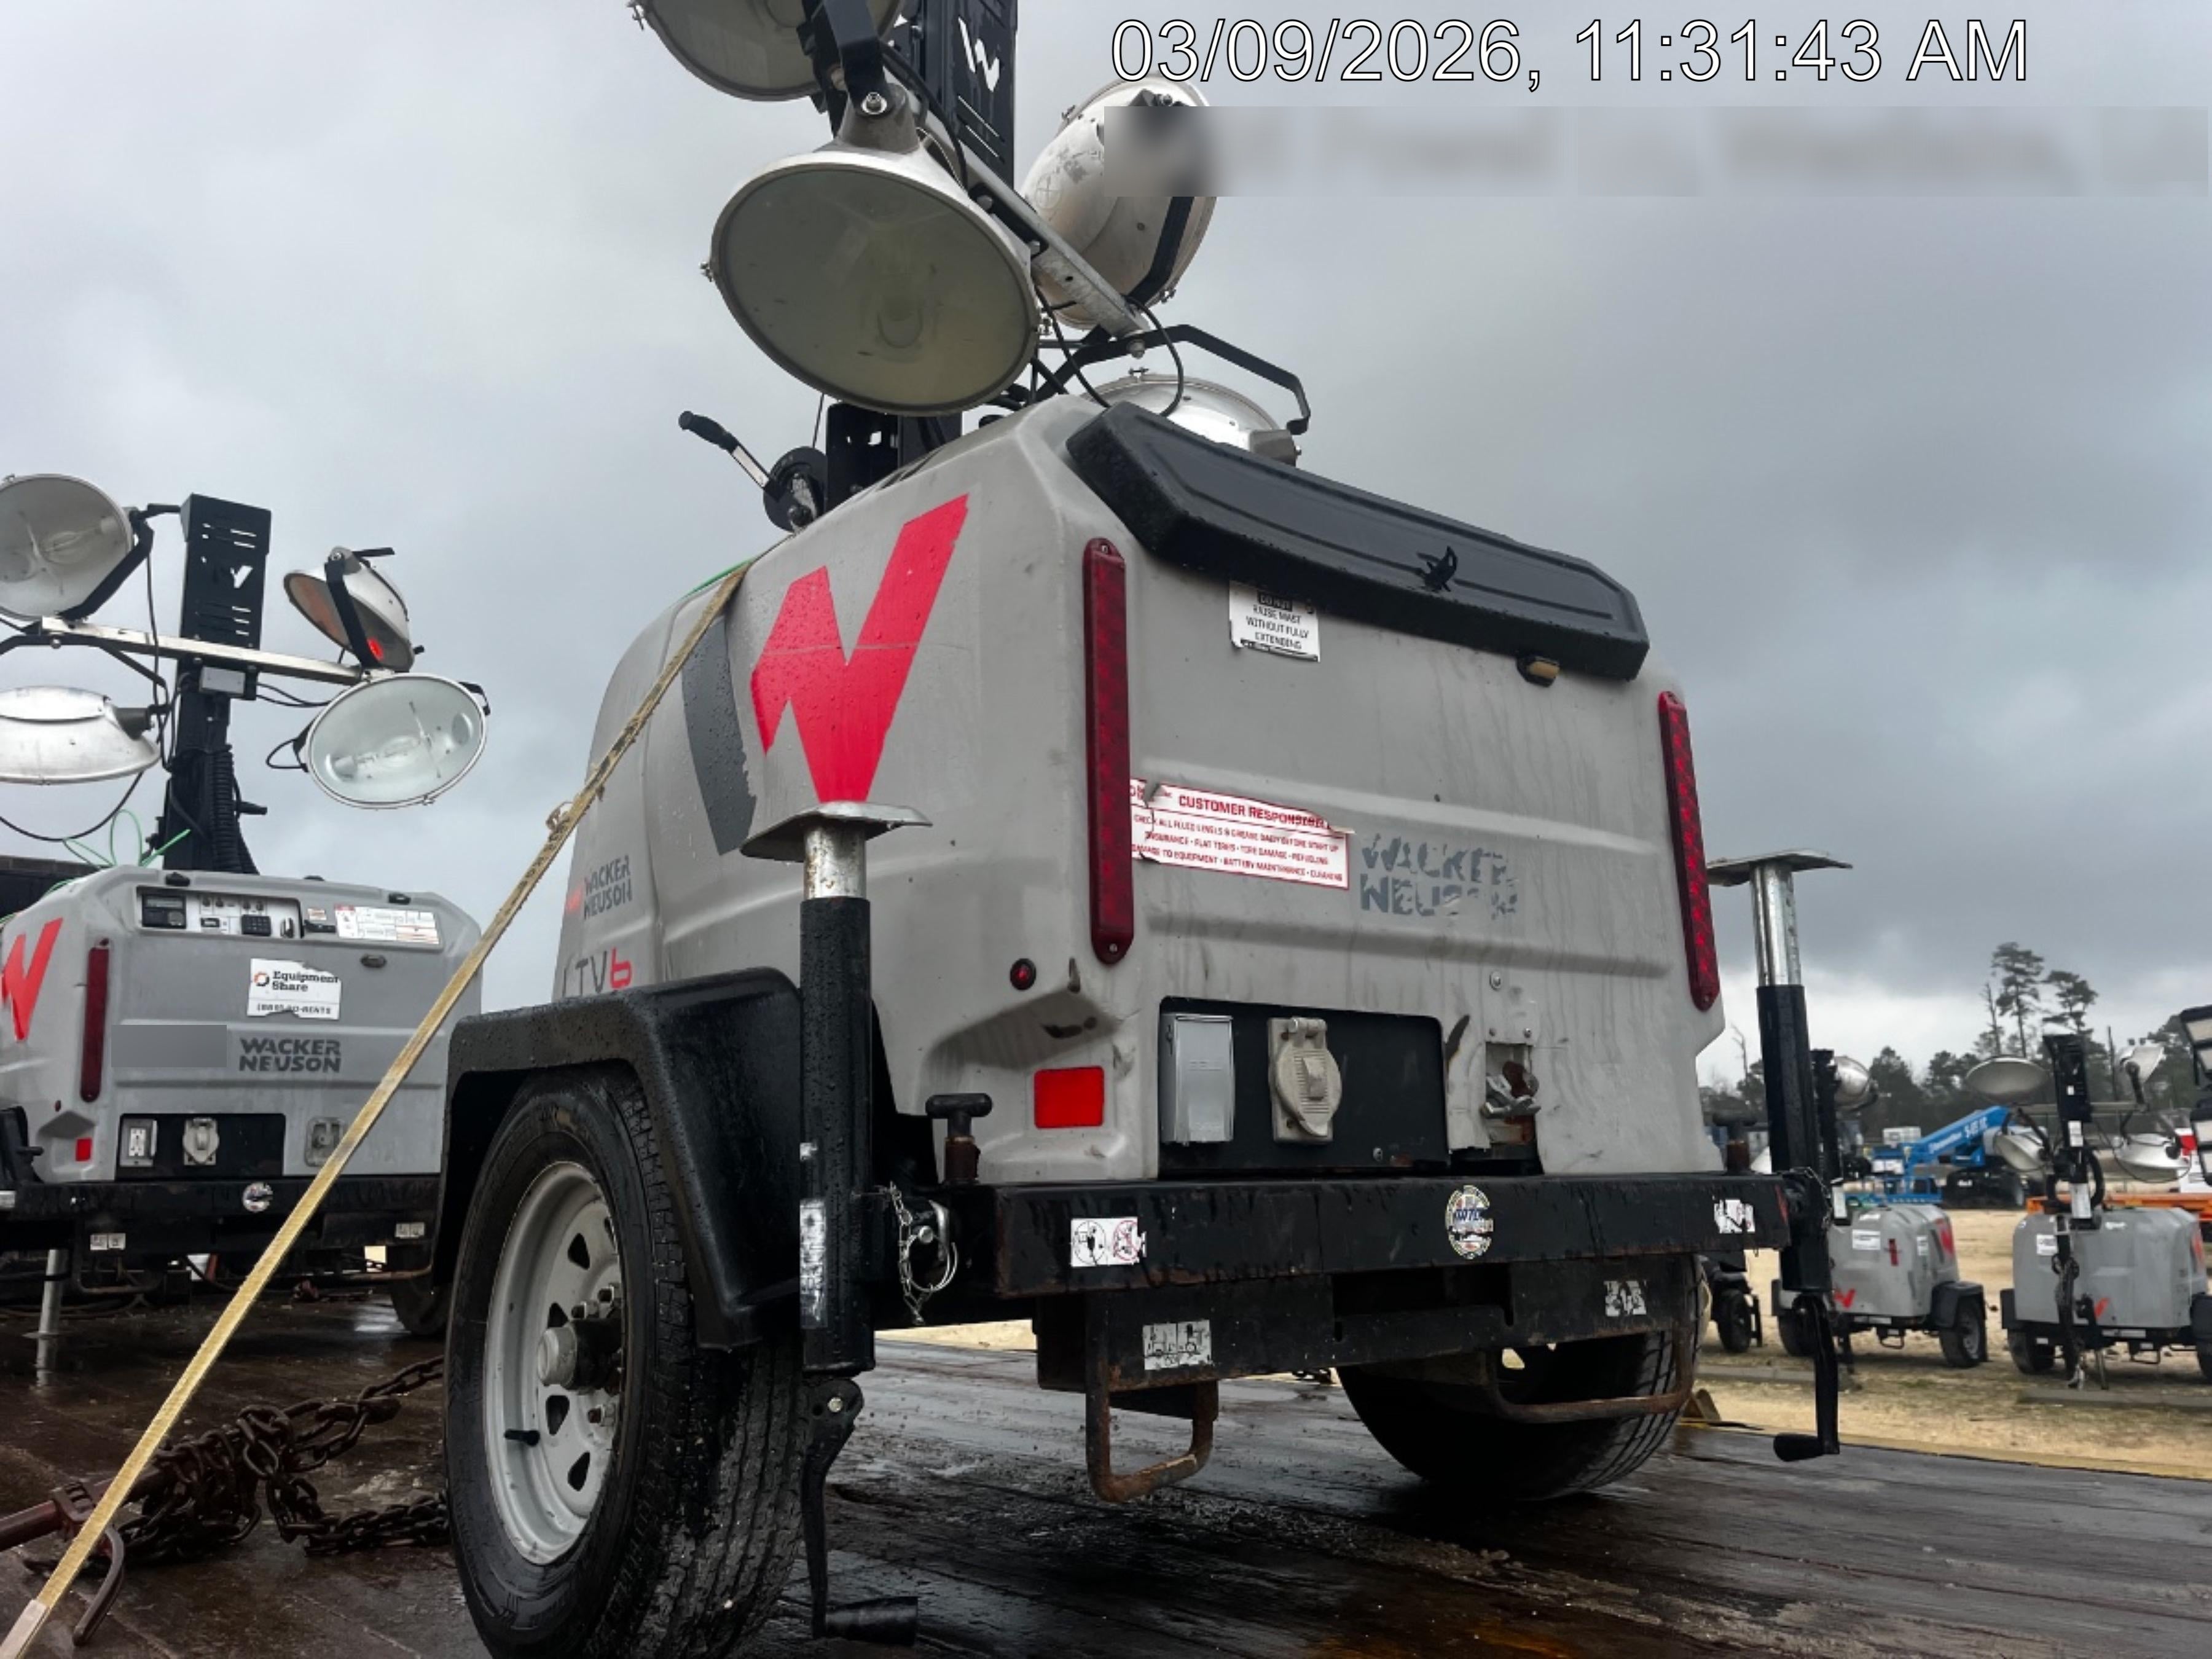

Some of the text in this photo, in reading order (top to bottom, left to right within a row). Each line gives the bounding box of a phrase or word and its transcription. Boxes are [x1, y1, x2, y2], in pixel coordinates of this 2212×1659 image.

[1245, 615, 1285, 633] WITHOUT
[1255, 632, 1302, 649] EXTENDING
[1179, 795, 1246, 817] CUSTOMER
[1163, 849, 1173, 858] TO
[273, 970, 339, 984] Equipment
[272, 981, 308, 992] Share
[240, 1037, 342, 1055] WACKER
[239, 1055, 342, 1073] NEUSON
